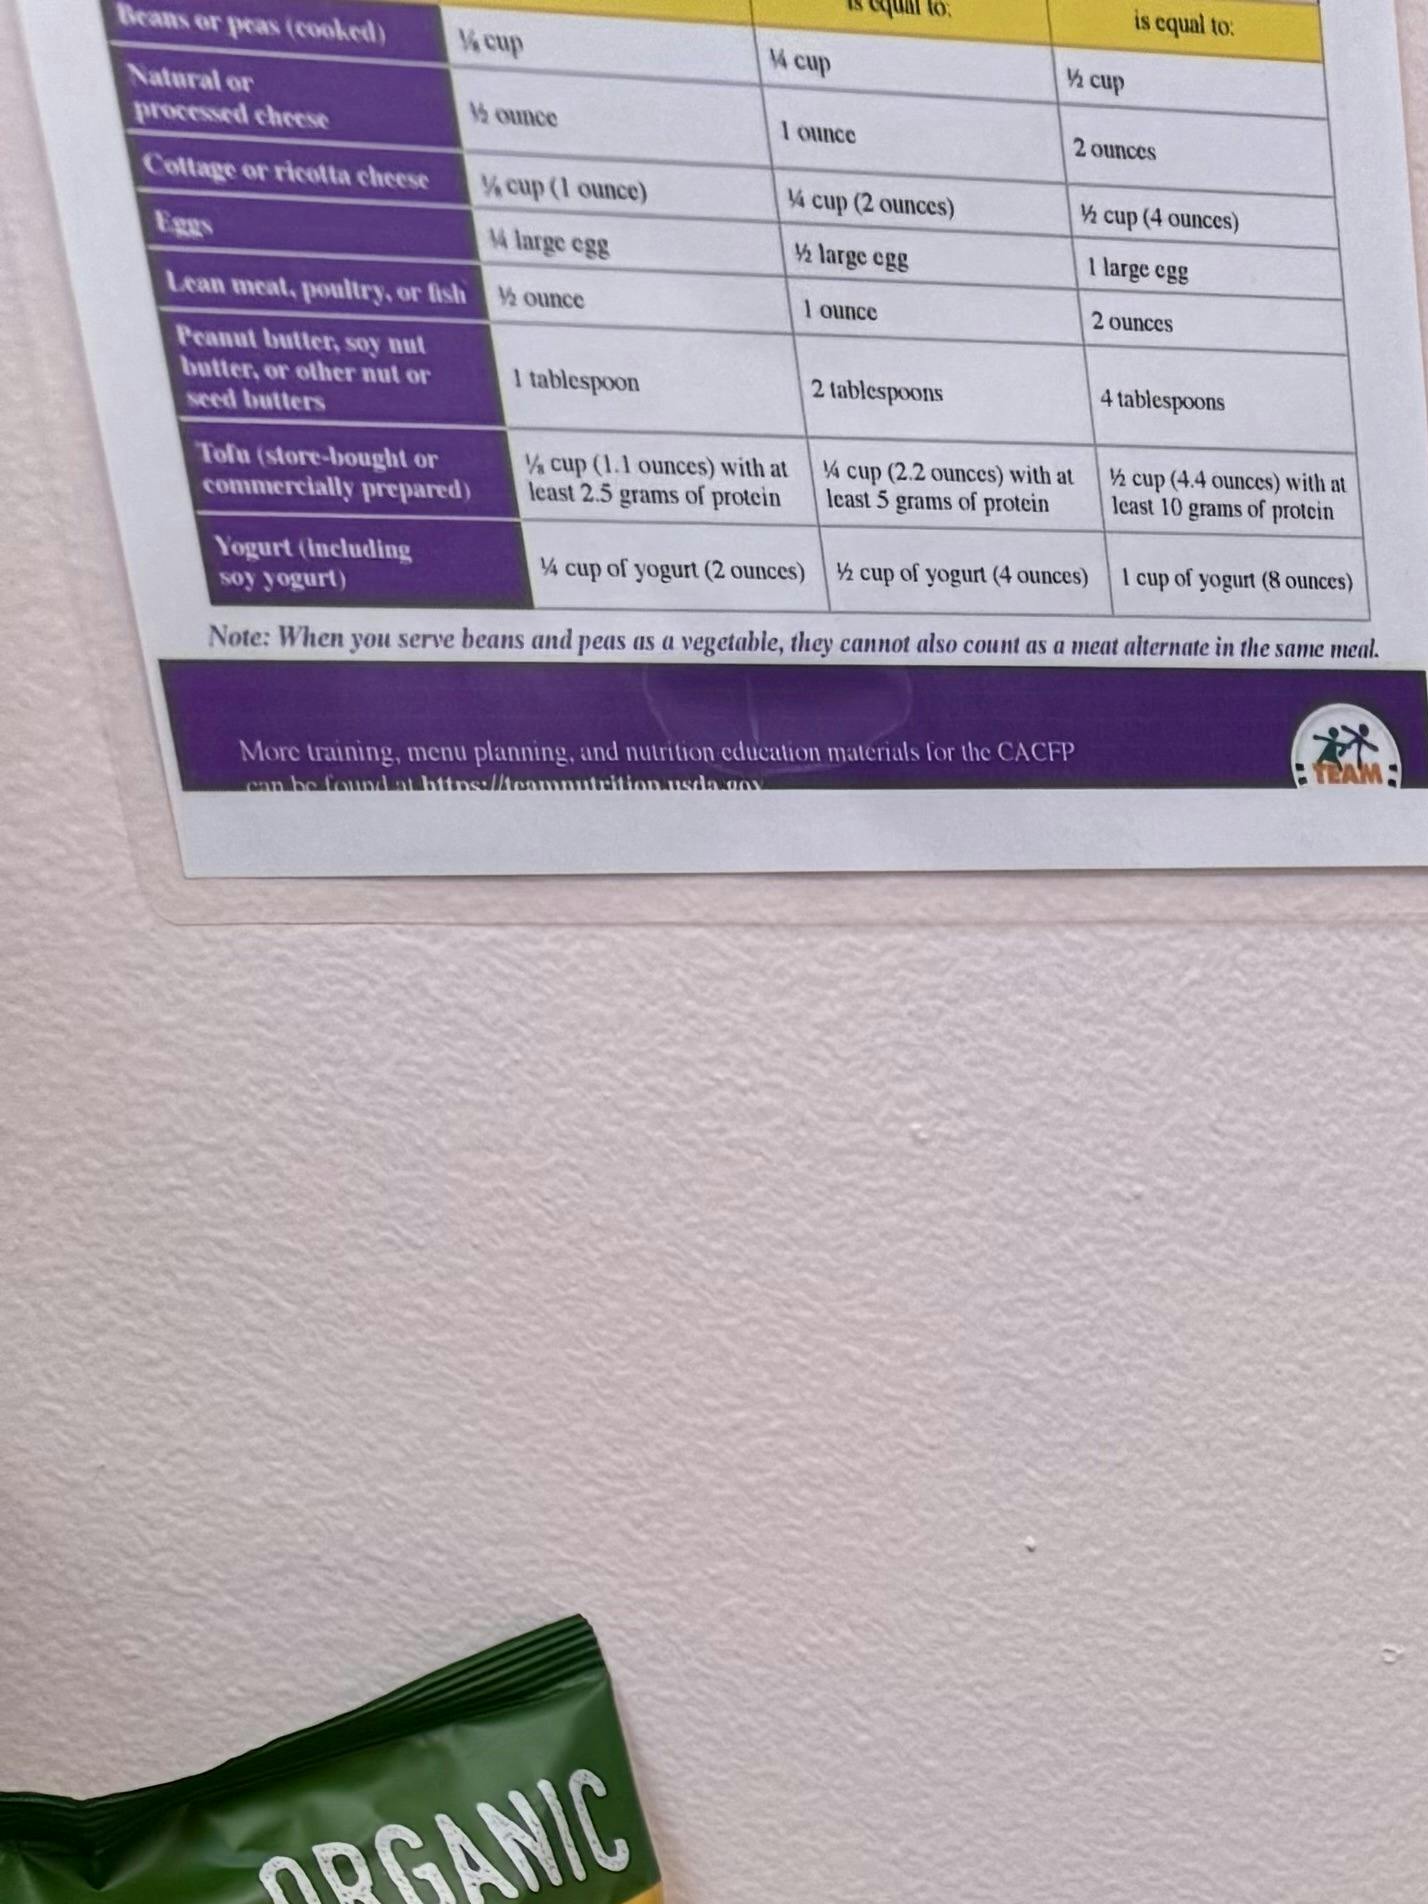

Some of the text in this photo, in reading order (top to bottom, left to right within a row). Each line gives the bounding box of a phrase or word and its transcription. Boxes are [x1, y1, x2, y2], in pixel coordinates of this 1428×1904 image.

[1156, 13, 1204, 40] equal
[1211, 16, 1234, 37] to:
[128, 62, 253, 93] Natural or
[134, 97, 329, 131] processed cheese
[1074, 139, 1157, 162] 2 ounces
[155, 211, 213, 241] Eggs
[1101, 391, 1226, 413] 4 tablespoons
